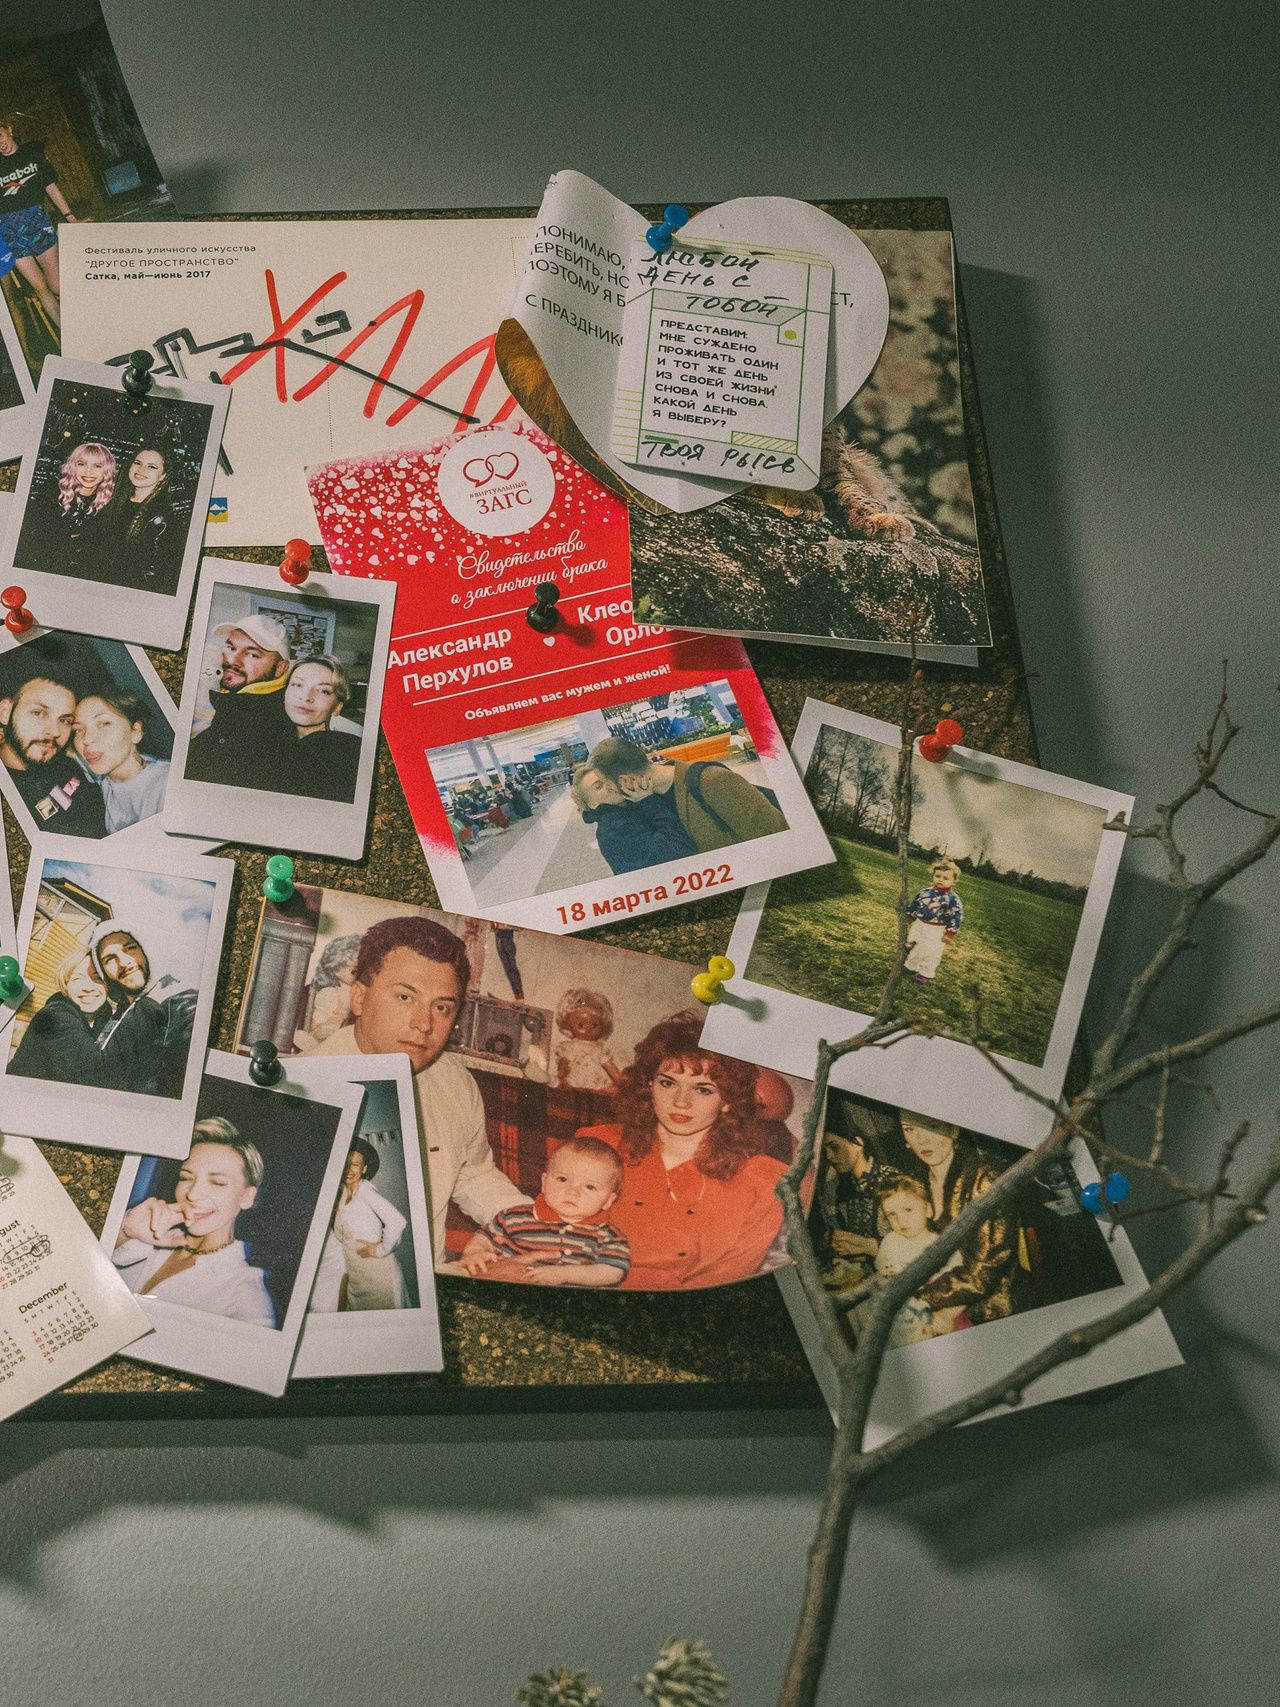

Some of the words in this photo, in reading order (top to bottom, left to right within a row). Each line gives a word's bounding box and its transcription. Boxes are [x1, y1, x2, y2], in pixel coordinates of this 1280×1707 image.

[84, 246, 143, 255] Фестиваль
[146, 247, 197, 255] уличного
[201, 245, 256, 254] искусства
[531, 242, 604, 281] ЕРЕБИТЬ,
[85, 272, 120, 281] Сатка,
[186, 270, 211, 279] 2017
[637, 266, 715, 287] ДЕНЬ
[603, 289, 612, 303] Я
[685, 295, 790, 318] ТОБОЙ
[525, 294, 537, 308] С
[541, 297, 624, 347] ПРАЗДНИК
[660, 319, 748, 339] ПРЕДСТАВИМ:
[659, 332, 686, 343] МНЕ
[693, 336, 757, 353] СУЖДЕНО
[658, 344, 736, 363] ПРОЖИВАТЬ
[743, 357, 779, 371] ОДИН
[656, 370, 672, 380] ИЗ
[680, 372, 724, 388] СВОЕЙ
[657, 357, 666, 366] И
[673, 360, 700, 371] ТОТ
[707, 365, 727, 375] ЖЕ
[734, 369, 768, 382] ДЕНЬ
[654, 383, 699, 398] СНОВА
[706, 391, 715, 400] И
[653, 396, 696, 410] КАКОЙ
[702, 404, 738, 417] ДЕНЬ
[652, 409, 661, 418] Я
[668, 411, 727, 428] ВЫБЕРУ?
[642, 441, 705, 461] ТВОЯ
[469, 480, 528, 499] #ВИРТУАЛЬНЫЙ
[476, 489, 532, 515] ЗАГС
[457, 529, 586, 580] Свидетельство
[450, 593, 462, 605] о
[463, 572, 558, 609] заключении
[562, 555, 608, 584] брака
[387, 628, 512, 670] Александр
[402, 655, 514, 693] Перхулов
[464, 695, 539, 721] Объявляем
[541, 689, 564, 705] вас
[565, 679, 612, 699] мужем
[613, 676, 623, 686] и
[623, 663, 672, 685] женой!
[556, 902, 586, 925] 18
[592, 885, 669, 917] марта
[673, 863, 734, 896] 2022
[19, 1282, 67, 1313] December
